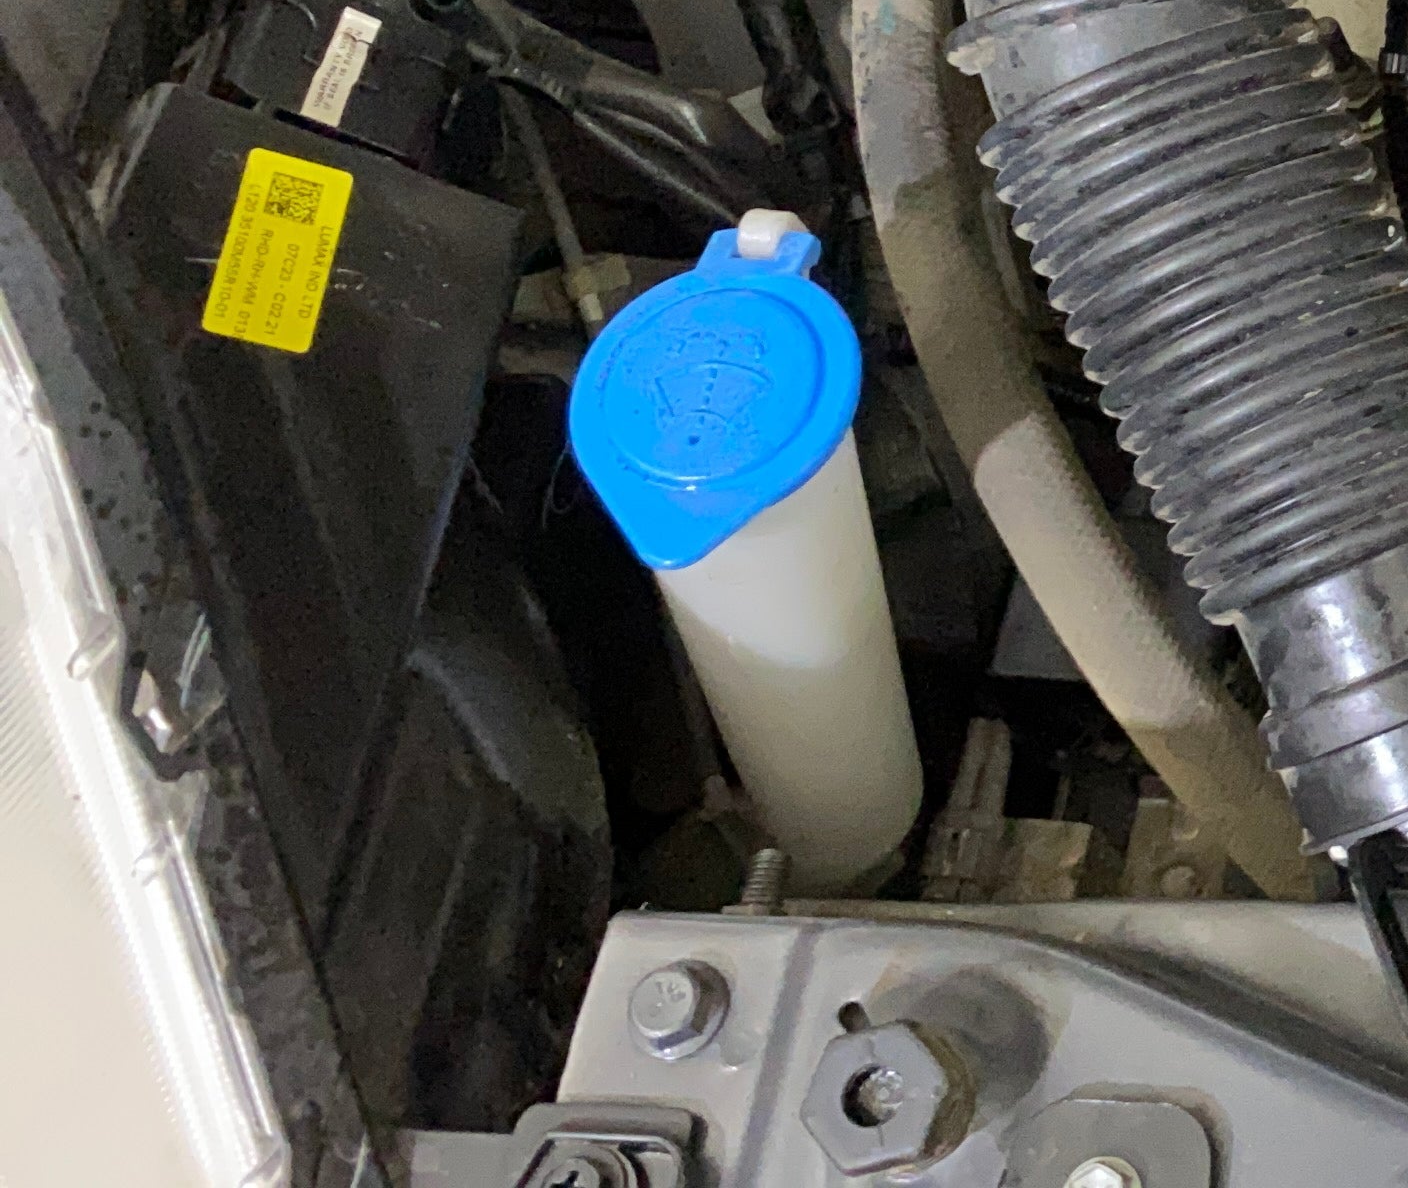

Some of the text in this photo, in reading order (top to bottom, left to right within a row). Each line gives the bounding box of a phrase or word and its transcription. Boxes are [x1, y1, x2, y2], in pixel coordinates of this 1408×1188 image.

[298, 225, 334, 320] LUMAX IND LTD
